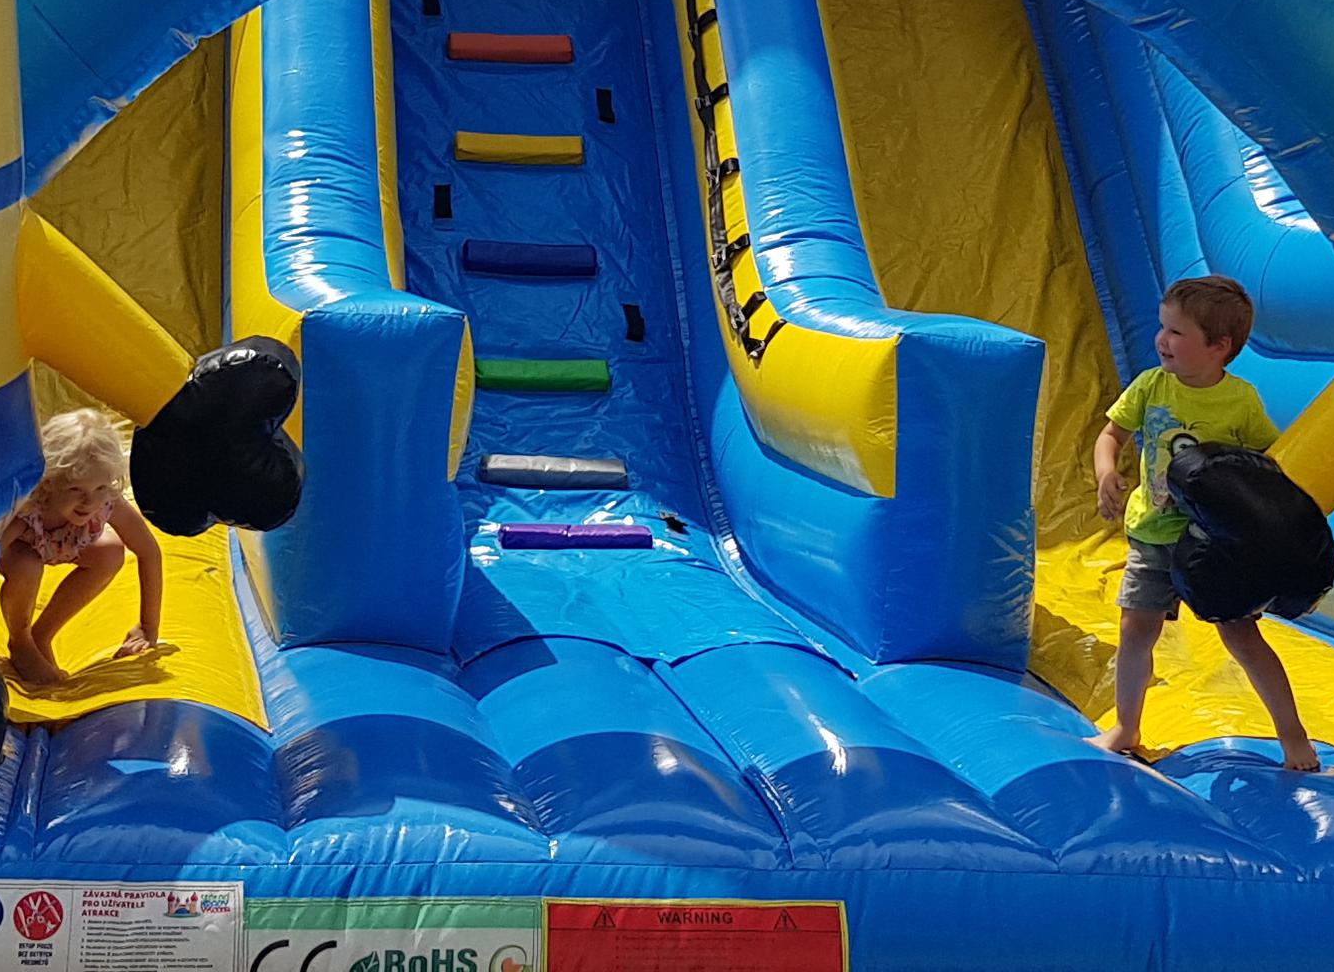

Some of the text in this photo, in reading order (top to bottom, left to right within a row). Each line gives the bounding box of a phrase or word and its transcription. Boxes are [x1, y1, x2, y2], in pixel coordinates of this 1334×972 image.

[124, 891, 166, 899] PRAVIDLA
[81, 909, 120, 917] ATRAKCE
[657, 911, 734, 925] WARNING
[384, 948, 478, 972] RoHS
